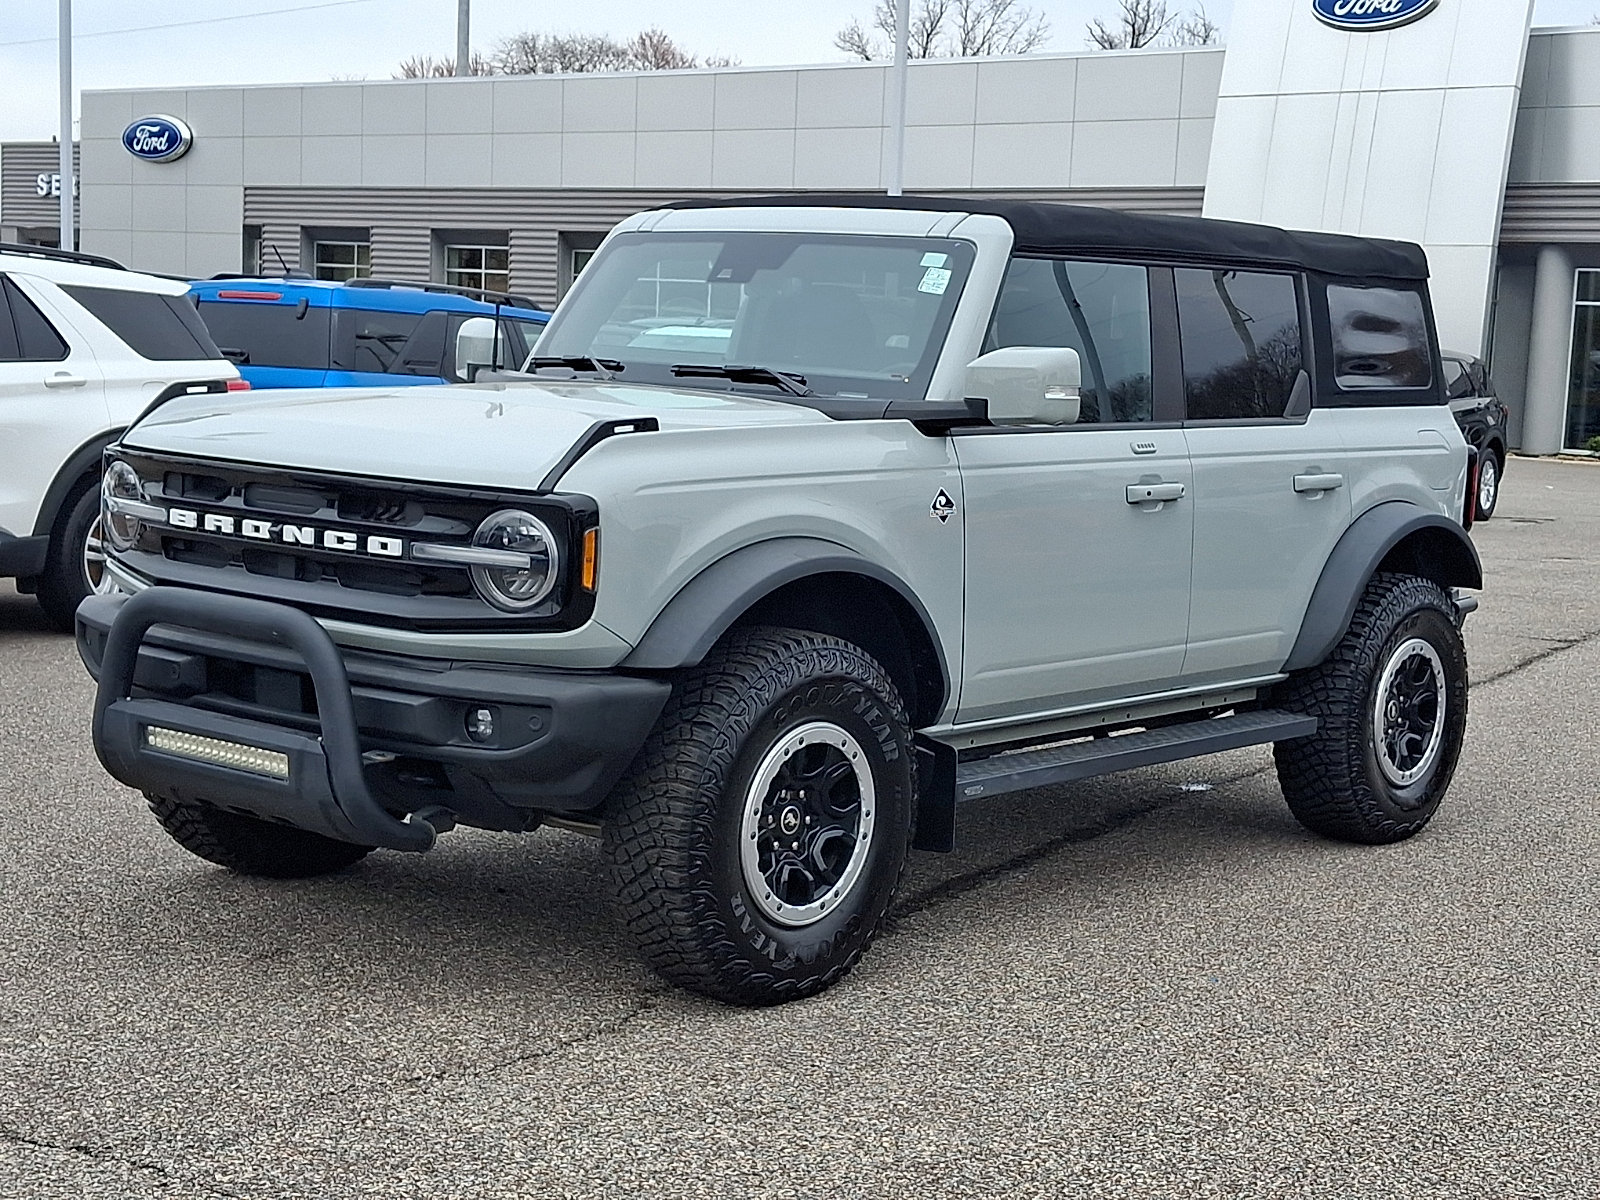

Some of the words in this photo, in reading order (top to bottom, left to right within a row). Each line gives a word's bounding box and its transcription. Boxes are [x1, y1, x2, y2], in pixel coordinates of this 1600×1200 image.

[133, 125, 168, 151] Ford
[37, 173, 78, 196] SE
[169, 508, 402, 557] BRONCO
